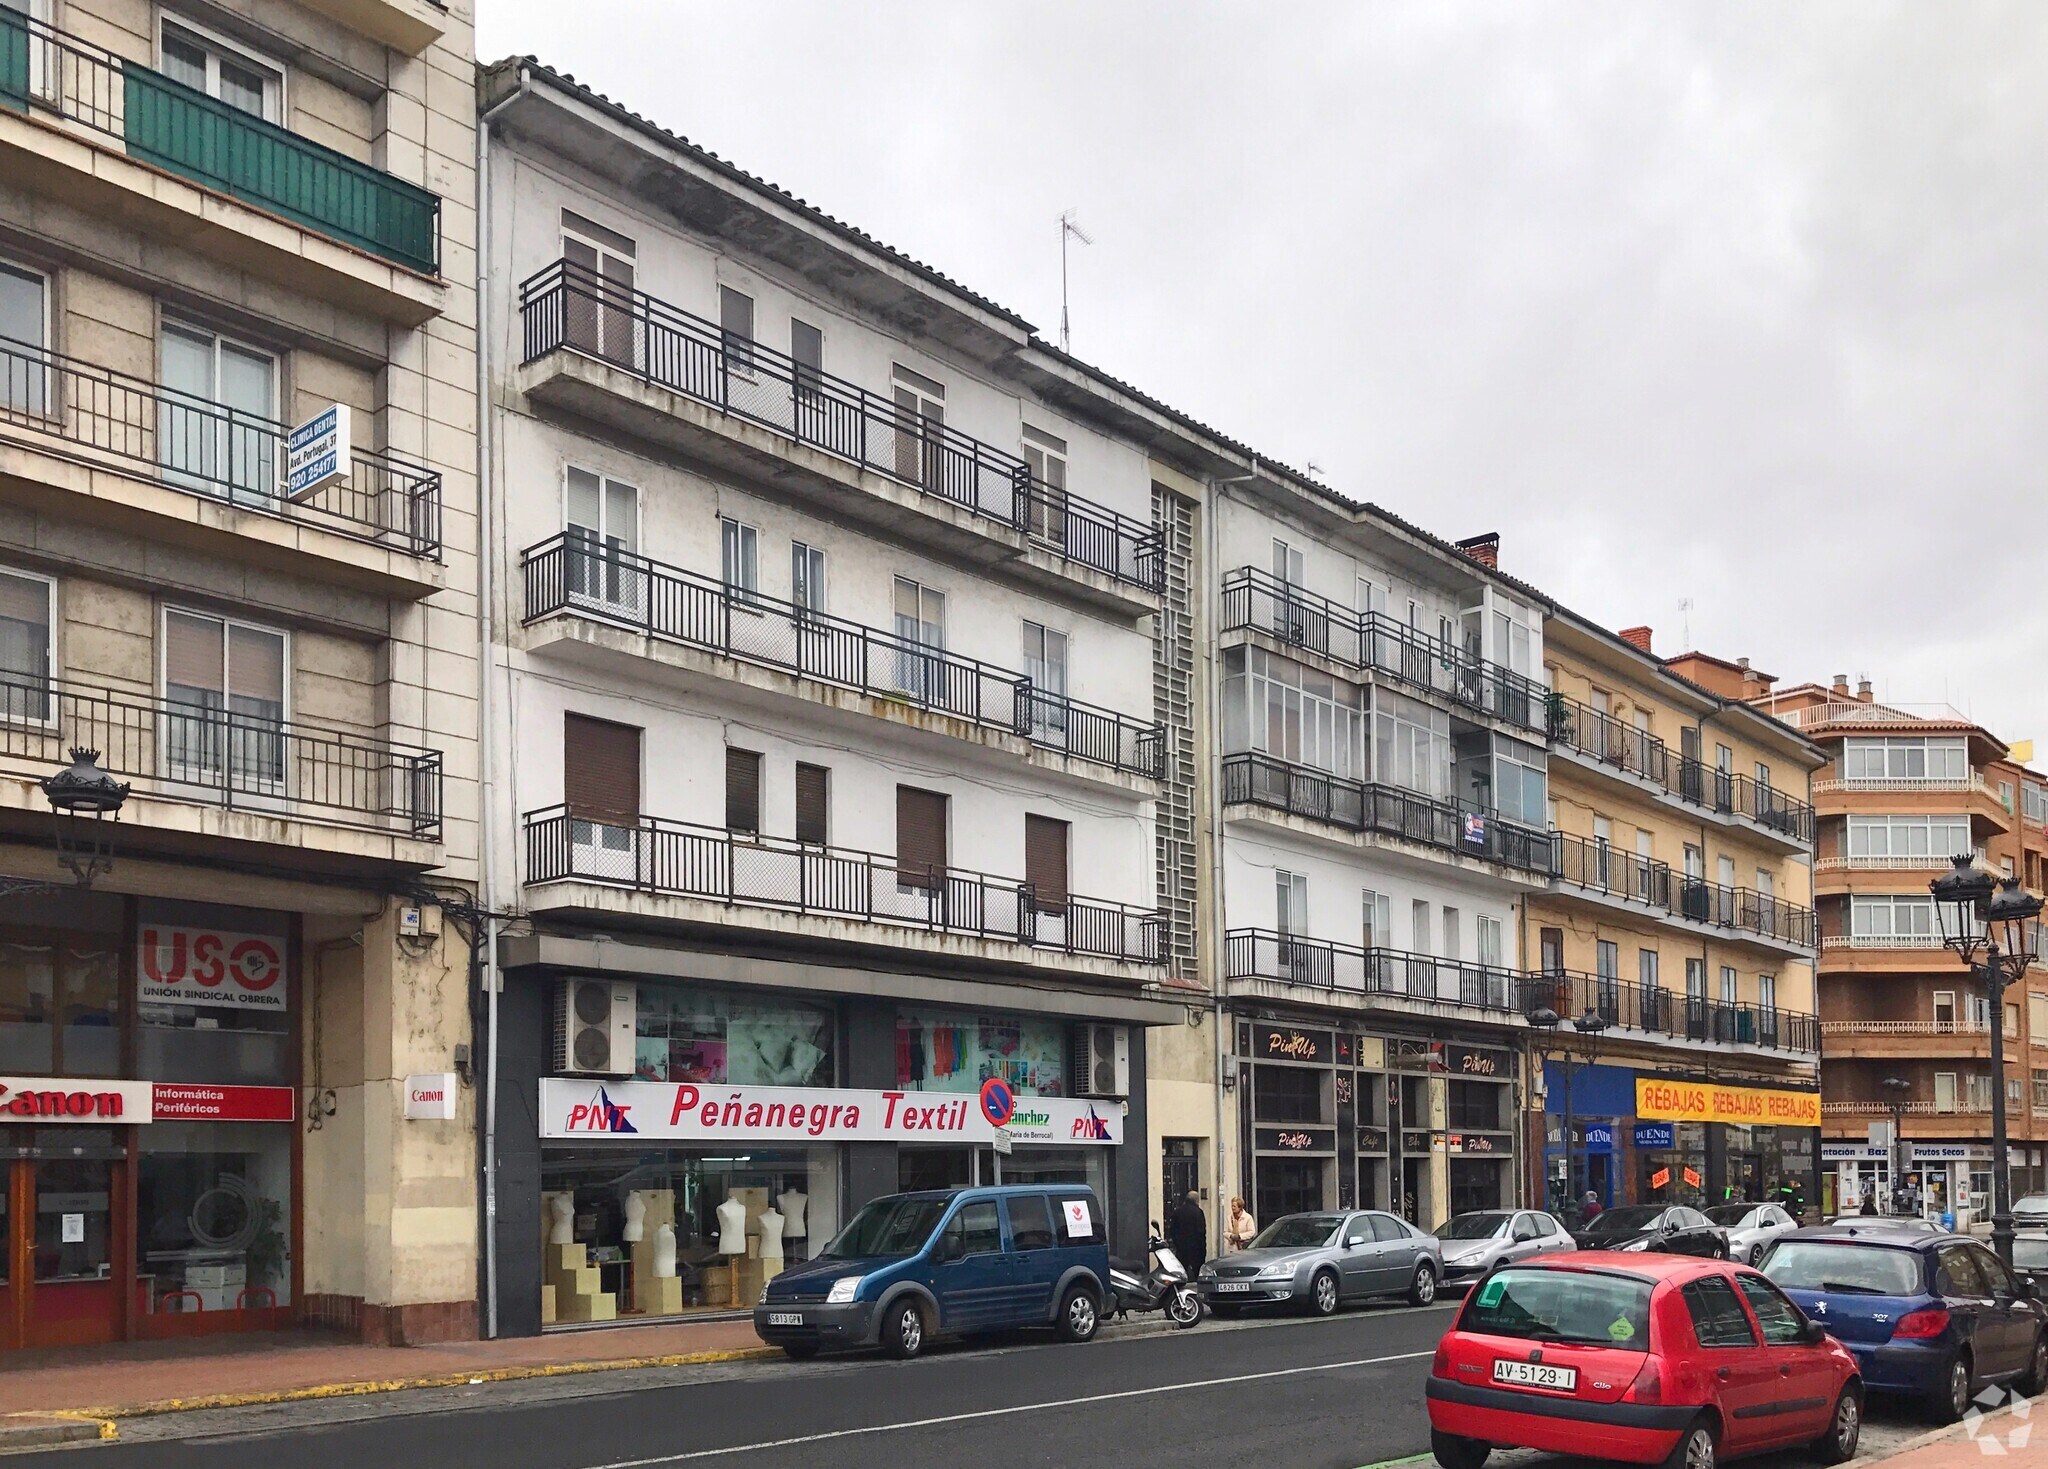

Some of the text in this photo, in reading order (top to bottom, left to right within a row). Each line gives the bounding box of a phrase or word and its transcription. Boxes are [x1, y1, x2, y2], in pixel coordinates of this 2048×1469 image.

[314, 413, 336, 433] DENTAL
[291, 454, 335, 490] 920 254177
[143, 929, 280, 991] USO
[143, 985, 280, 1005] UNIÓN SINDICAL OBRERA
[1269, 1033, 1317, 1059] Pin Up
[0, 1084, 123, 1116] anon
[155, 1088, 224, 1101] Informática
[411, 1089, 444, 1103] Canon
[1645, 1087, 1816, 1119] REBAJAS REBAJAS REBAJAS
[155, 1102, 220, 1114] Periféricos
[568, 1104, 632, 1131] PNT
[670, 1085, 968, 1136] Peñanegra Textil
[1072, 1117, 1109, 1138] PNT
[1635, 1128, 1670, 1139] DUENDE
[1822, 1148, 1888, 1156] ntación Baz
[1914, 1148, 1940, 1156] Frutos
[1942, 1148, 1965, 1156] Secos
[770, 1314, 787, 1323] 5813
